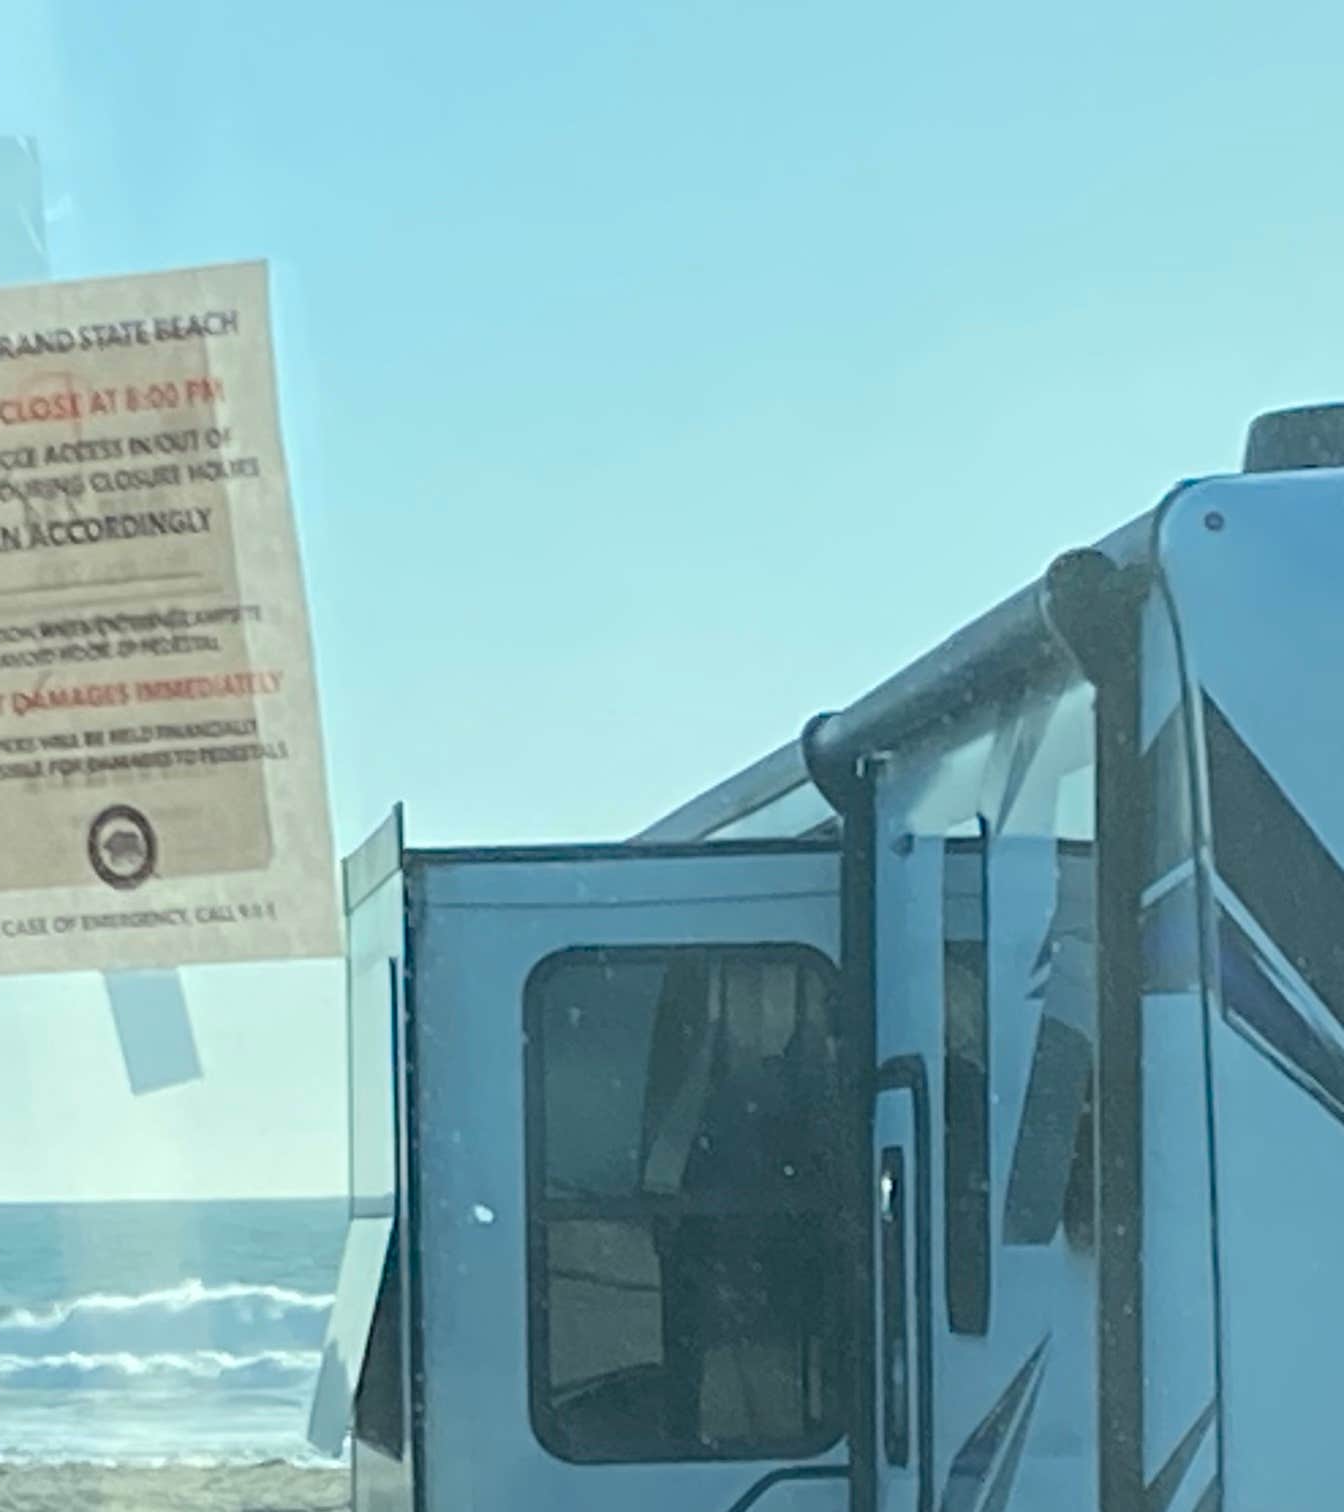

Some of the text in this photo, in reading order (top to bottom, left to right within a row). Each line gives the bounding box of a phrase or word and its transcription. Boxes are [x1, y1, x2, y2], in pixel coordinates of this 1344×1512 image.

[78, 320, 150, 351] STATE
[153, 310, 238, 342] BEACH
[90, 387, 117, 414] AT
[185, 376, 225, 407] PM
[43, 438, 123, 465] ACCESS
[89, 465, 182, 494] CLOSURE
[26, 506, 212, 550] ACCORDINGLY
[11, 683, 129, 717] DAMAGES
[134, 671, 284, 704] IMMEDIATELY
[1, 916, 49, 938] CASE
[194, 904, 238, 924] CALL
